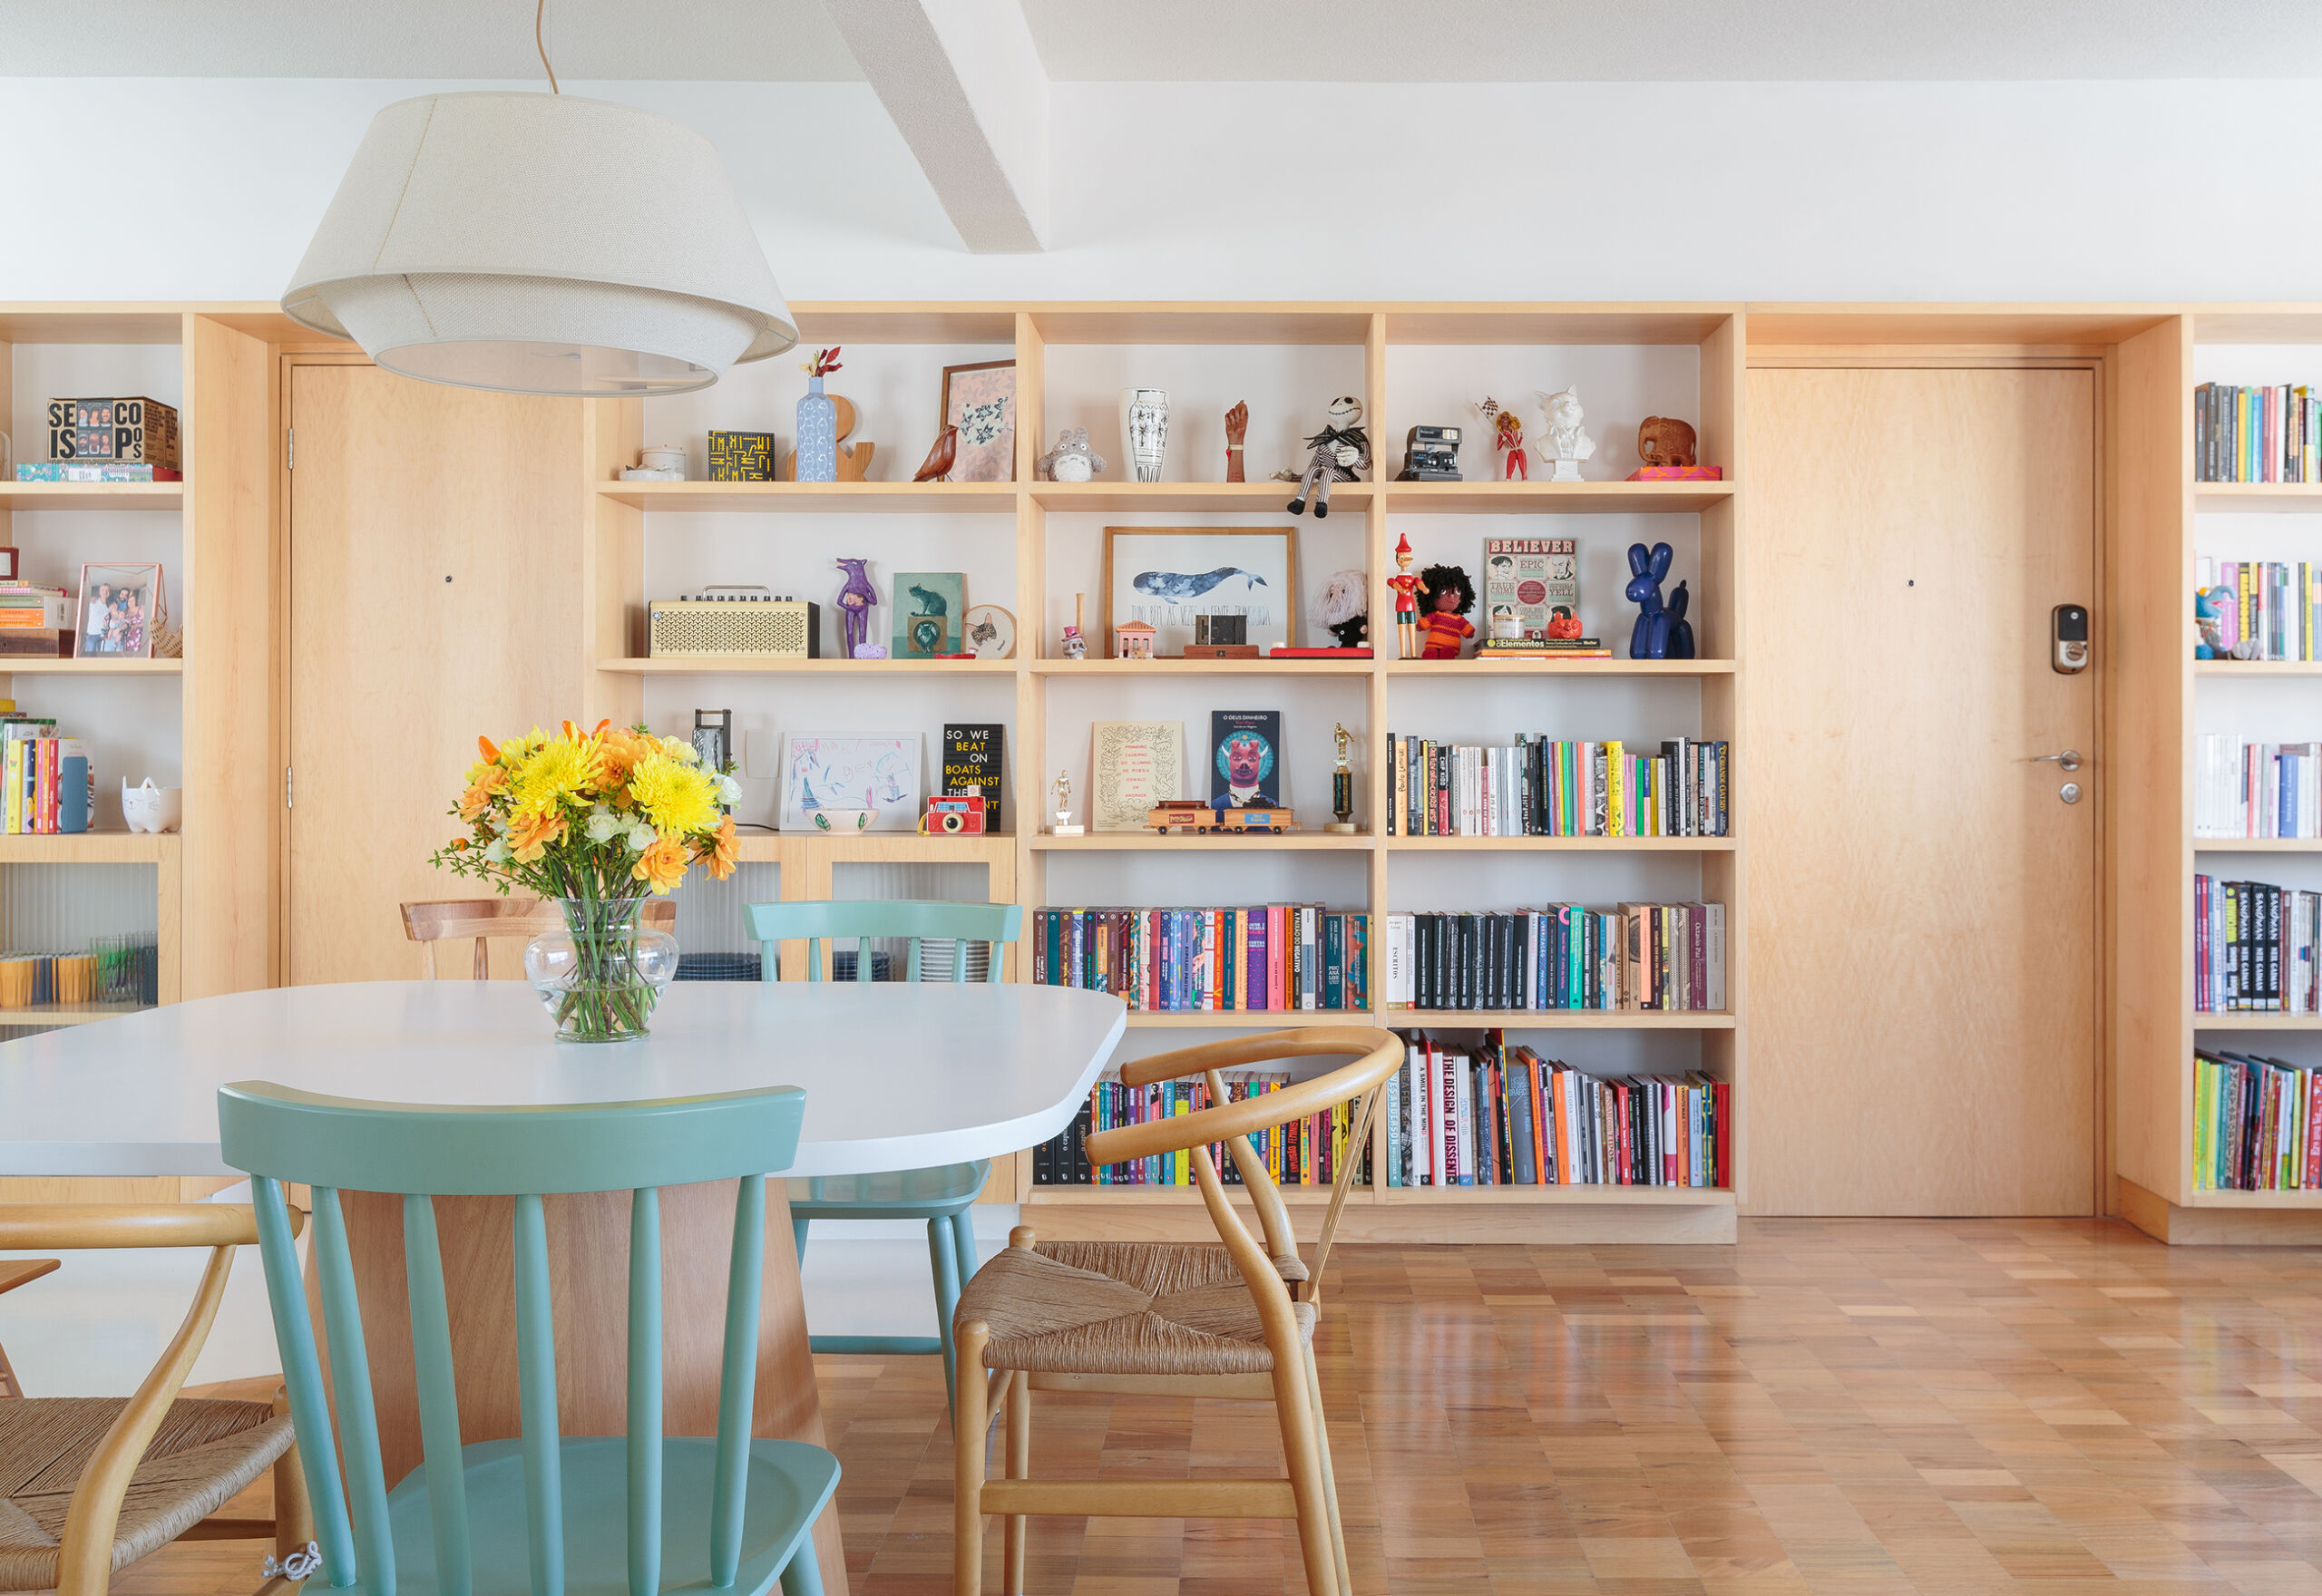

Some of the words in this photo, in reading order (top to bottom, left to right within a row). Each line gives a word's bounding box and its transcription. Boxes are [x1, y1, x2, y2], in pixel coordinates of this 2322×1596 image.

[1490, 540, 1573, 553] BELIEVER
[947, 730, 962, 739] SO
[971, 731, 989, 739] WE
[956, 742, 985, 751] BEAT
[970, 754, 988, 763] ON
[946, 765, 981, 774] BOATS
[950, 777, 1000, 785] AGAINST
[2239, 892, 2249, 940] SANDMAN
[2255, 892, 2265, 940] SANDMAN
[2270, 892, 2278, 940] SANDMAN
[1294, 937, 1301, 945] DO
[1443, 1058, 1454, 1075] THE
[1400, 1070, 1410, 1088] BEA
[1166, 1088, 1171, 1098] UM
[1443, 1078, 1455, 1114] DESIGN
[1390, 1096, 1400, 1145] ANDERSON
[1445, 1120, 1456, 1132] OF
[1445, 1135, 1457, 1177] DISSENT
